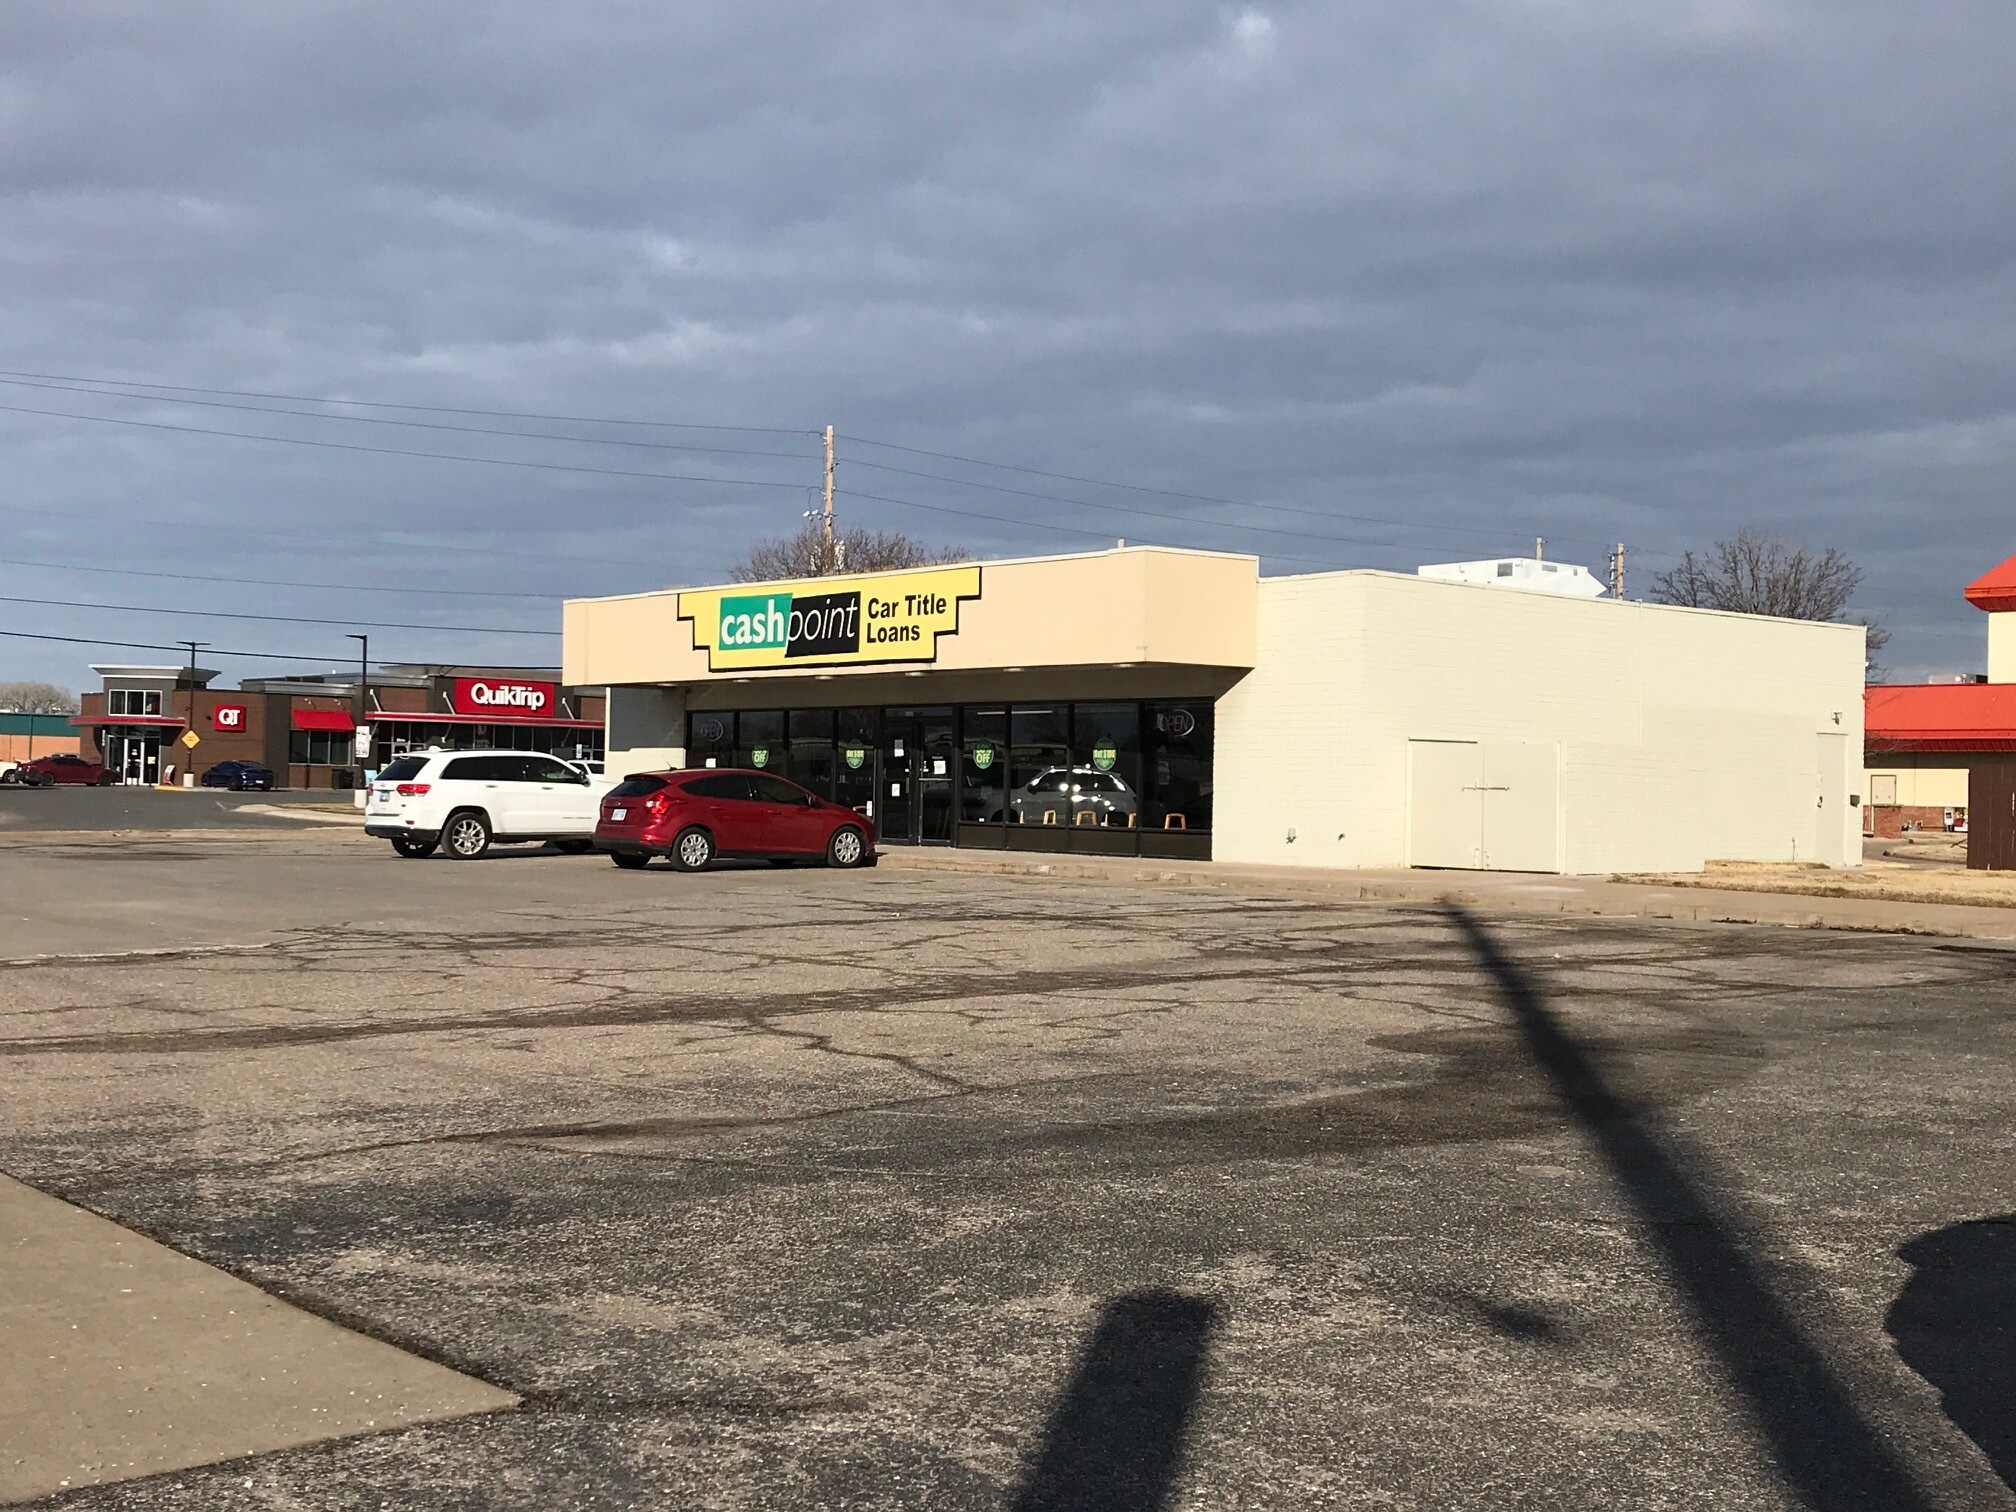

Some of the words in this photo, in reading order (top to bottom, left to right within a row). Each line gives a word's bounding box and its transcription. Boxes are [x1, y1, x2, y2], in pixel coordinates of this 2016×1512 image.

[868, 597, 899, 619] Car
[905, 593, 946, 616] Title
[867, 622, 920, 643] Loans
[471, 683, 545, 710] QuikTrip
[218, 708, 240, 726] QT
[976, 753, 990, 763] OFF
